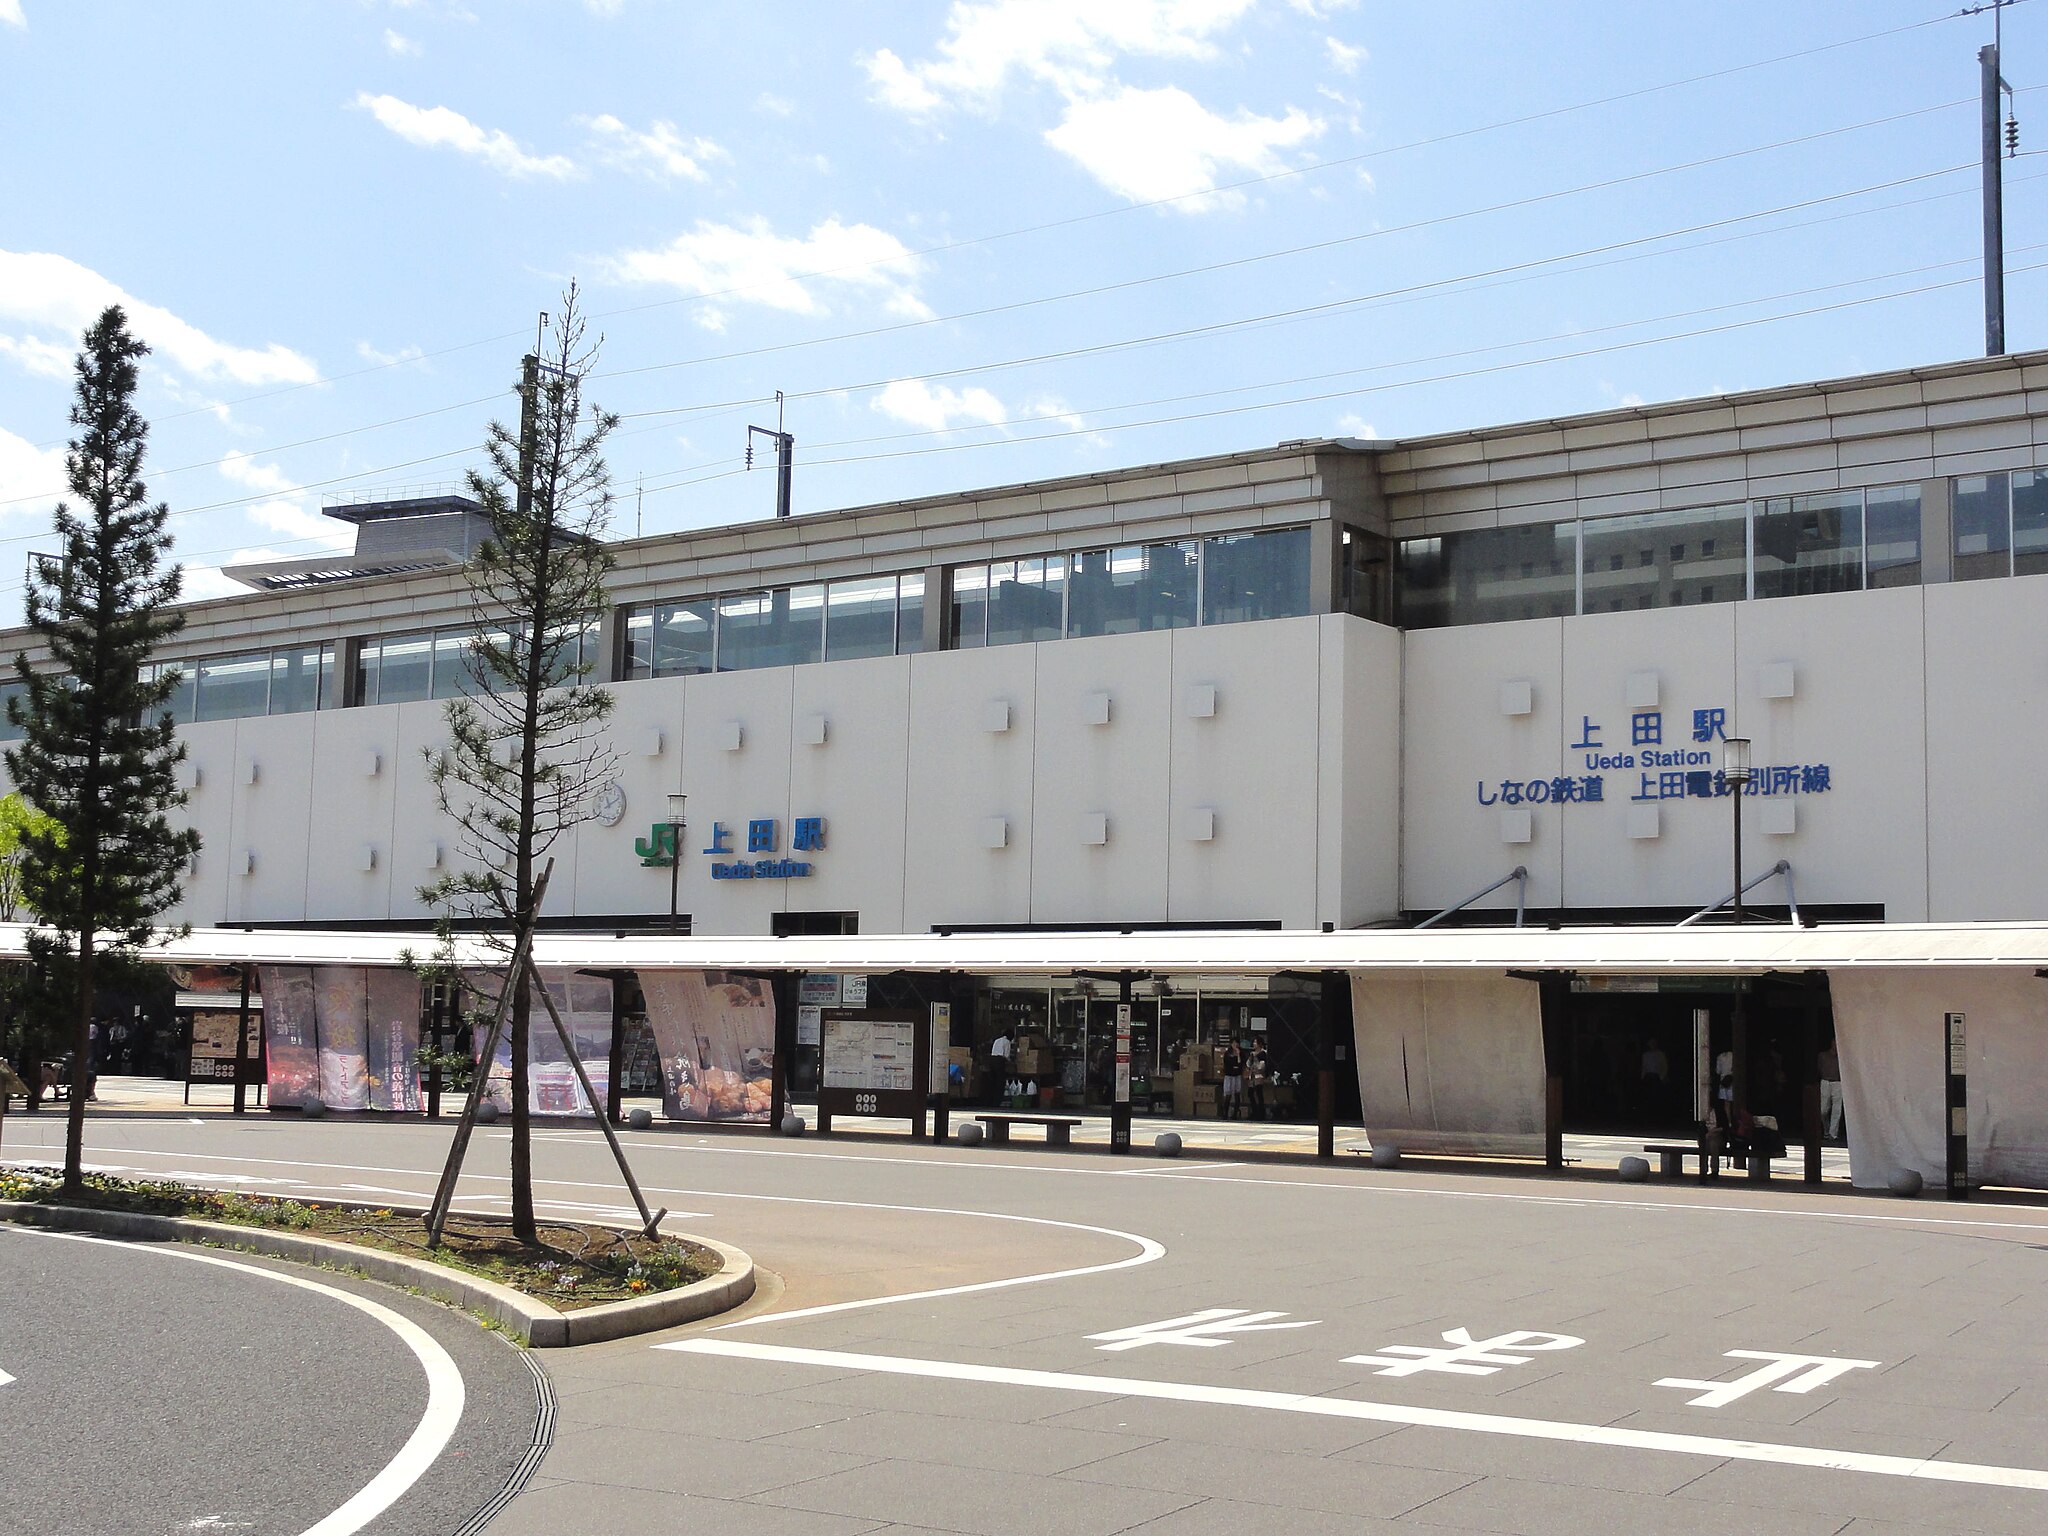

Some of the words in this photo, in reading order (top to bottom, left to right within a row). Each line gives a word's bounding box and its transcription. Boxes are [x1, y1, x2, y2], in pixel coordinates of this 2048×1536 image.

[1571, 707, 1726, 749] 上田駅
[1586, 752, 1634, 770] Ueda
[1640, 748, 1711, 768] Station
[1477, 775, 1604, 806] しなの鉄道
[703, 817, 827, 855] 上田駅
[711, 859, 754, 880] Ueda
[754, 857, 816, 879] Station
